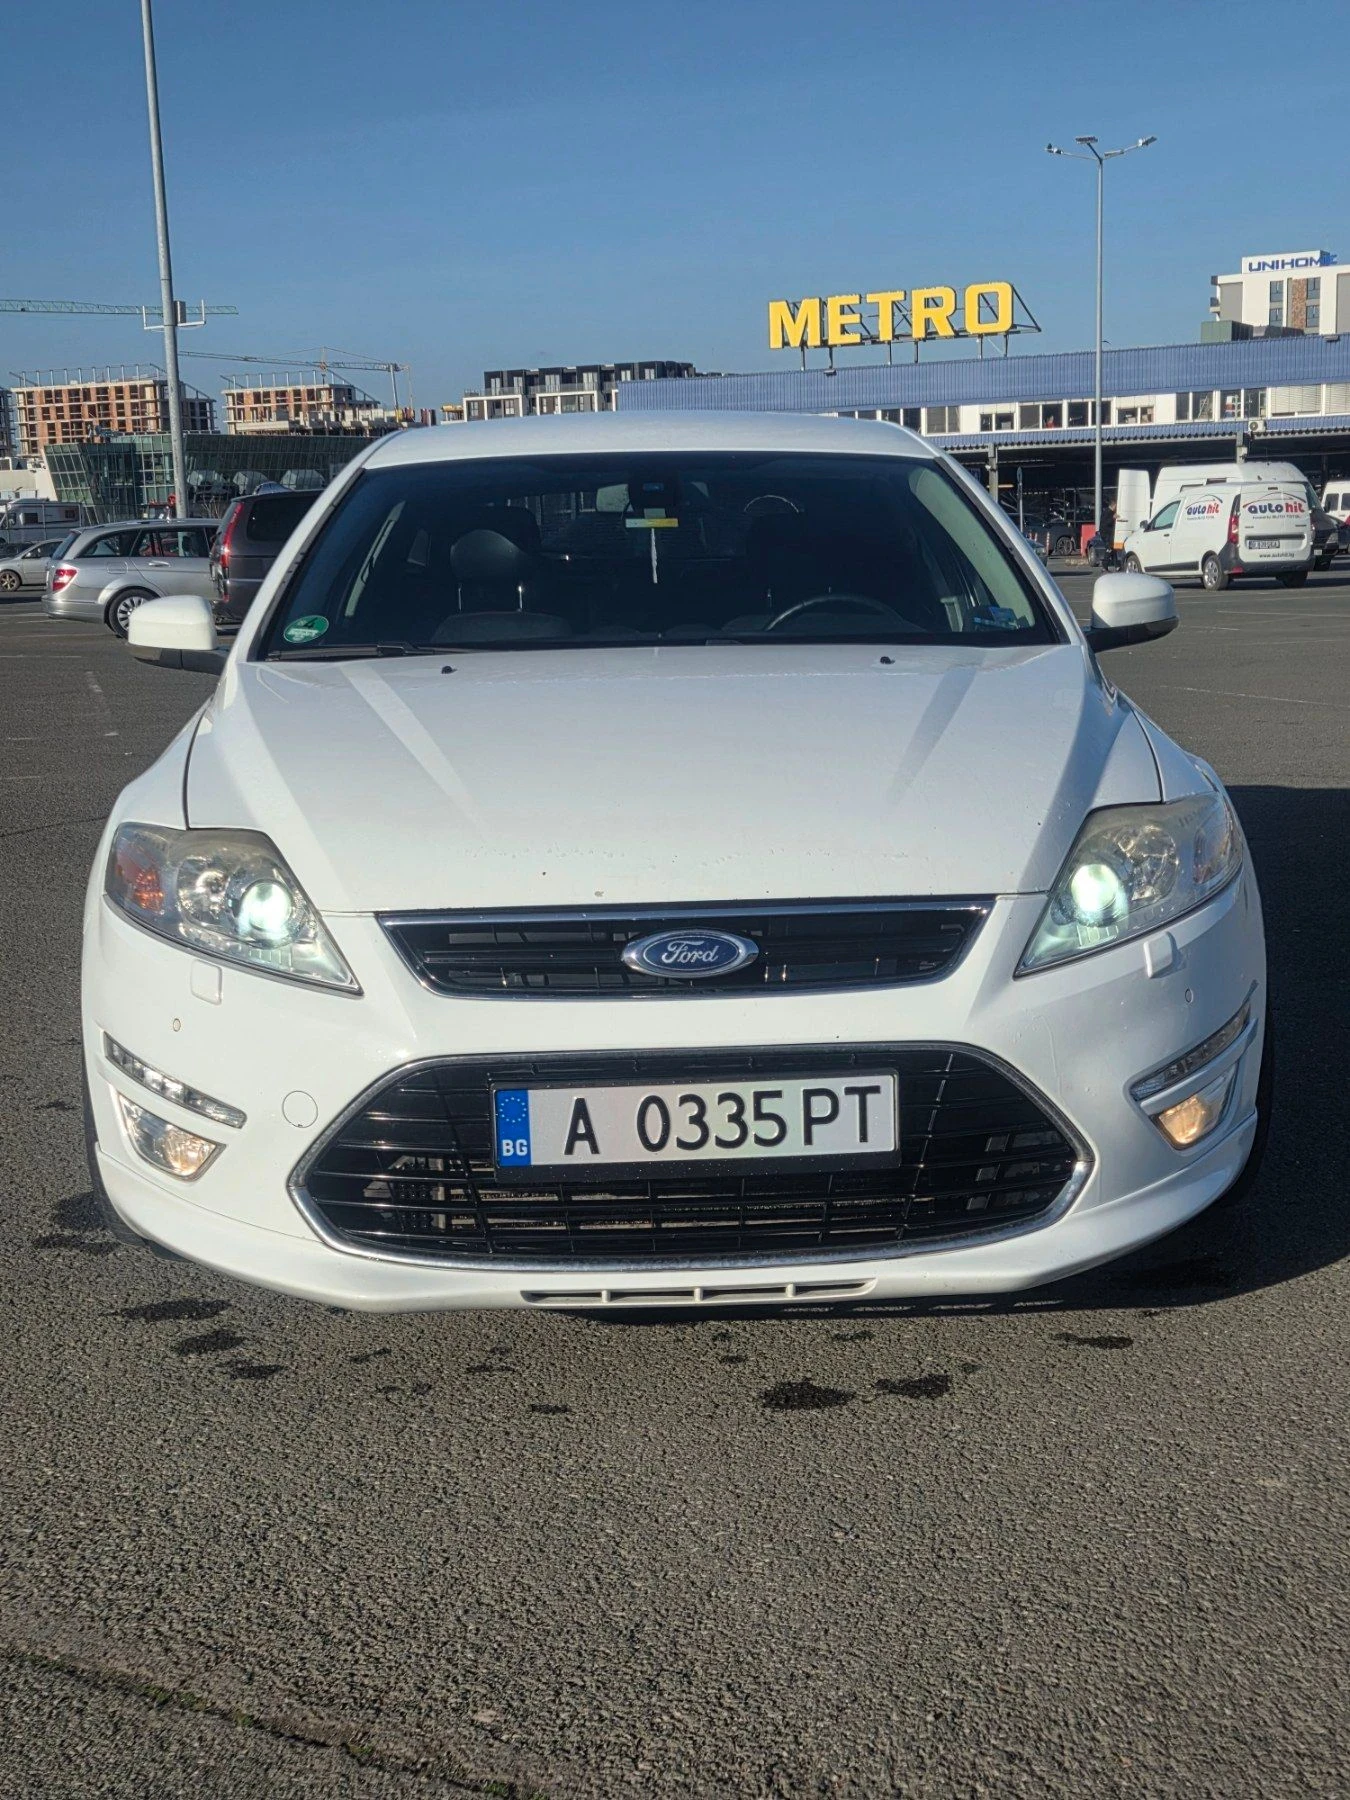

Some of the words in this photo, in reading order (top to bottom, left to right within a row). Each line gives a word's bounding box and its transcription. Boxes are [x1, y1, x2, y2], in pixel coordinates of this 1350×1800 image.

[768, 281, 1014, 349] METRO
[662, 940, 719, 964] Ford
[564, 1096, 600, 1156] A
[502, 1139, 529, 1157] BG
